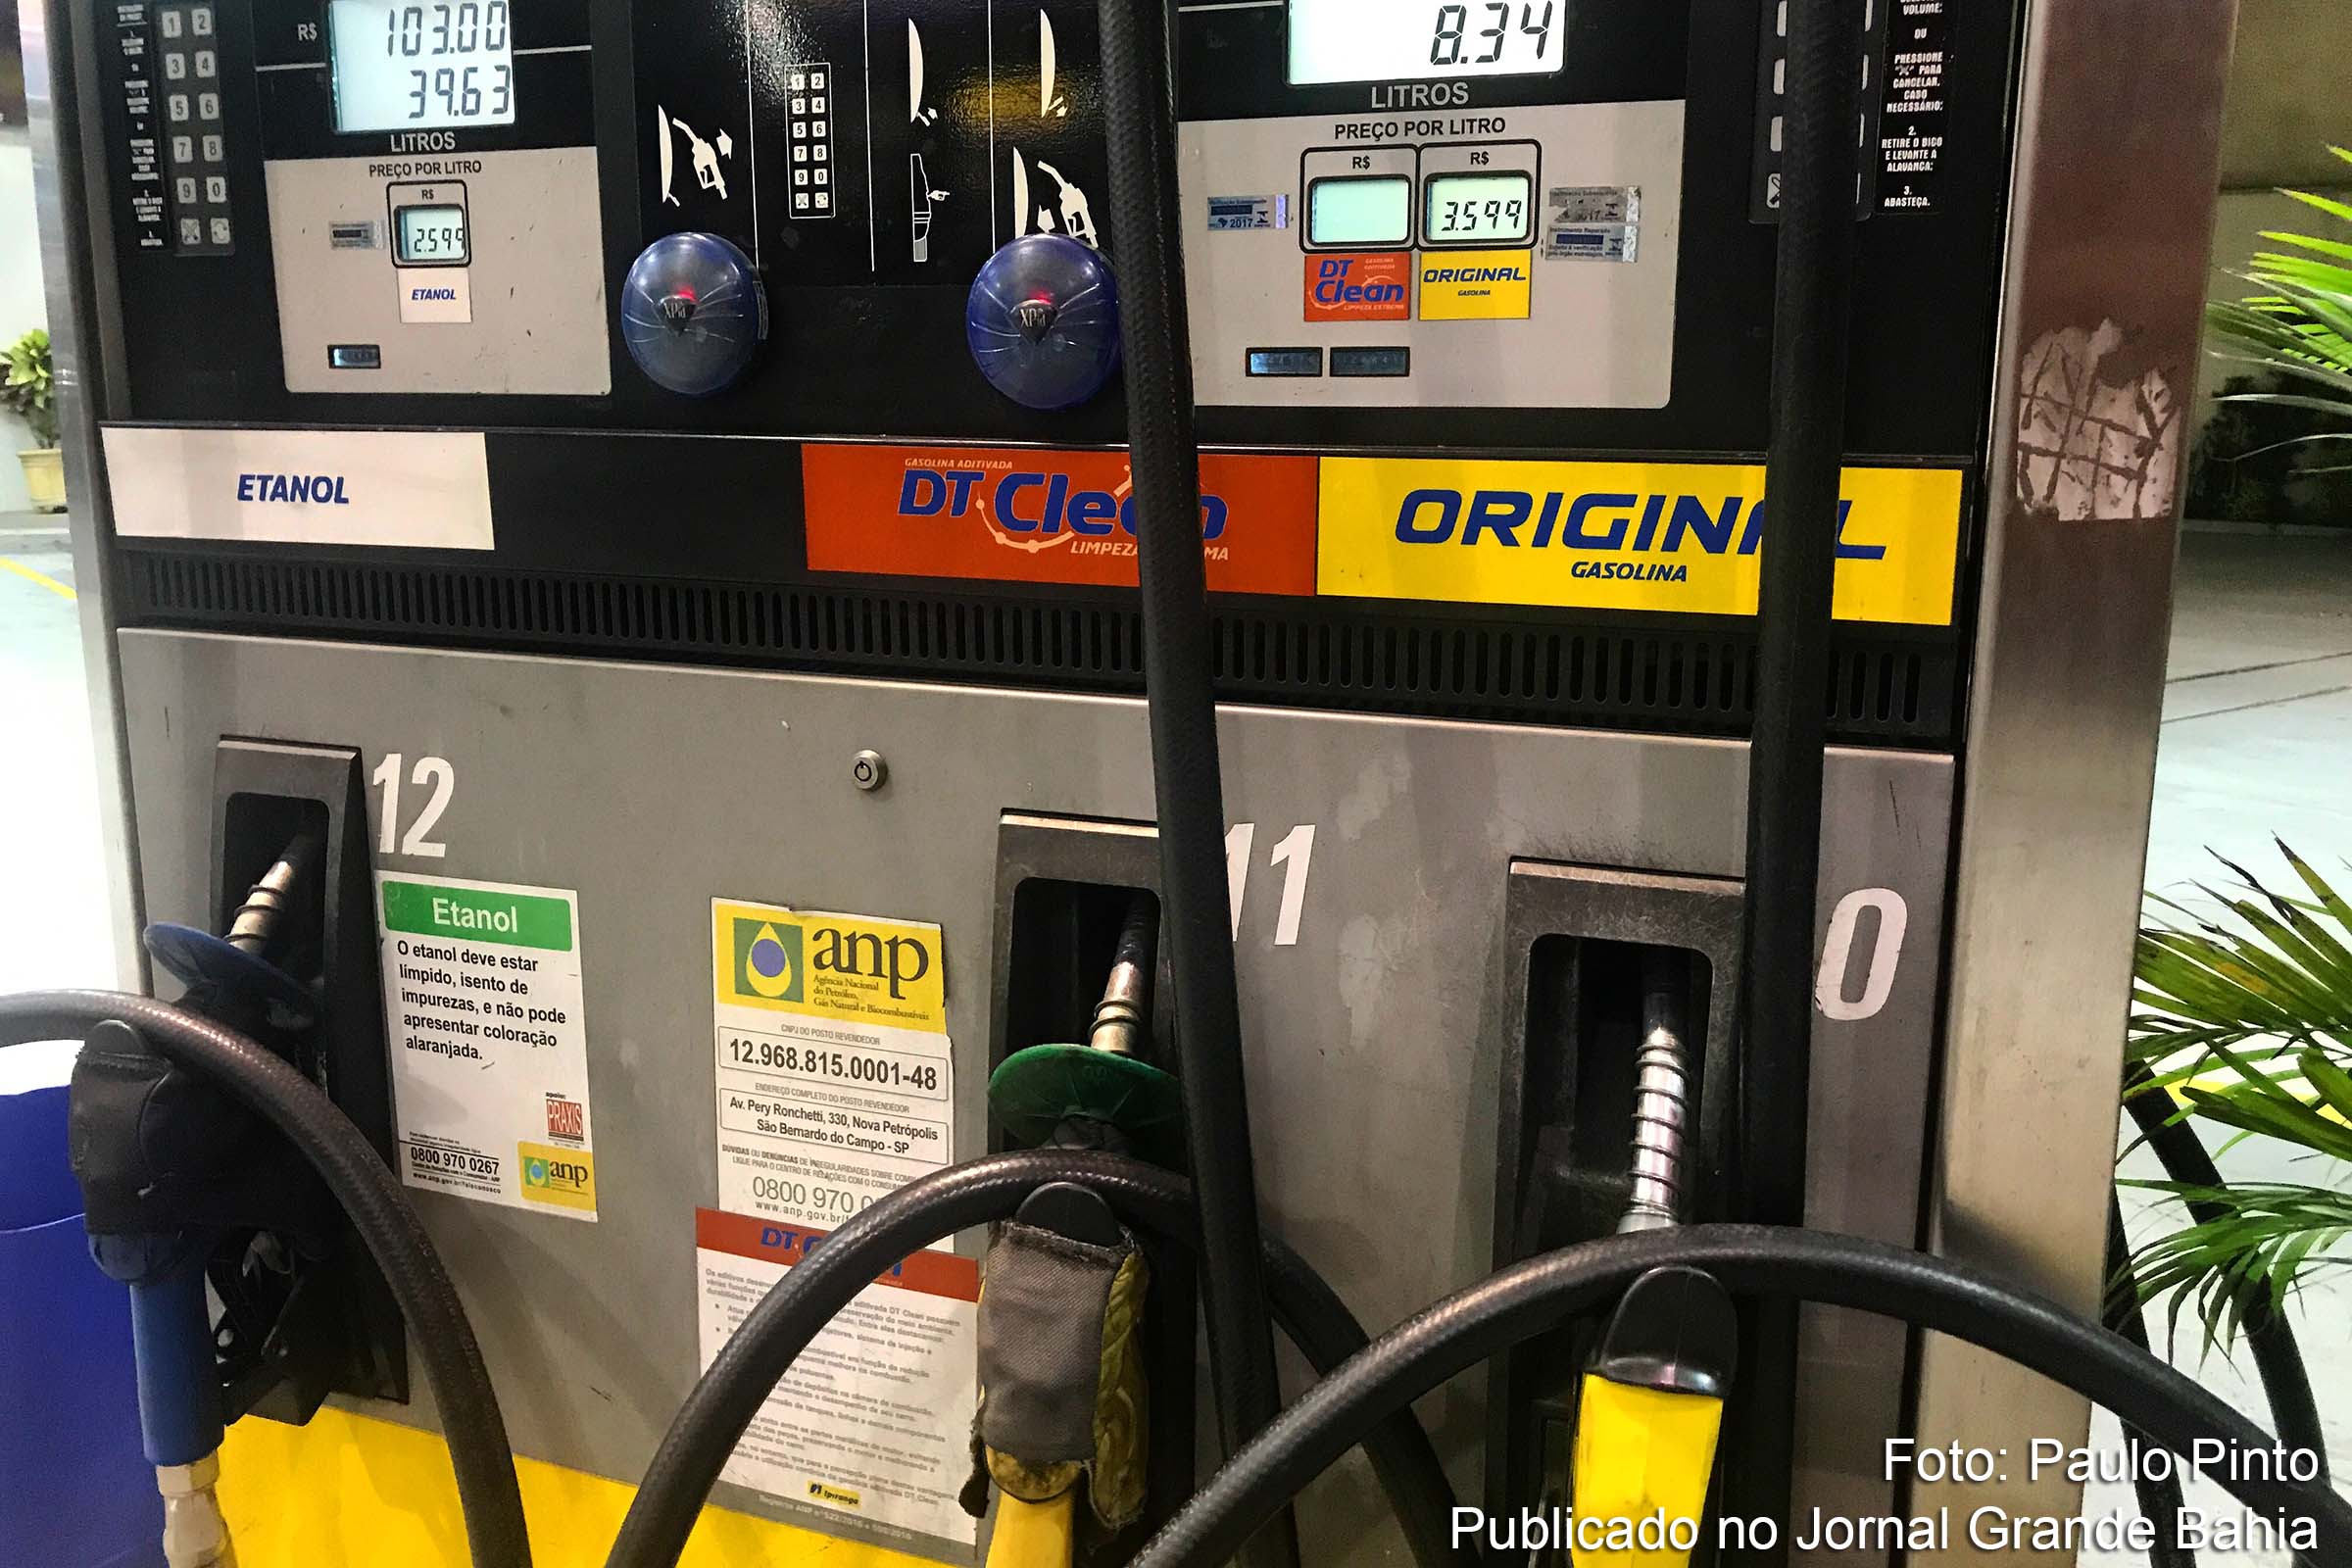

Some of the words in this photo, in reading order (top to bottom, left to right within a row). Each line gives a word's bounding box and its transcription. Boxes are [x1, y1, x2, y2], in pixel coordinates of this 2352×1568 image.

[198, 15, 206, 29] 2
[297, 23, 318, 42] R$
[387, 1, 507, 56] 103.00
[1430, 1, 1552, 65] 8.34
[1914, 27, 1927, 39] OU
[172, 60, 179, 74] 3
[202, 57, 210, 71] 4
[1894, 51, 1943, 64] PRESSIONE
[1919, 64, 1941, 74] PARA
[409, 65, 511, 119] 39.63
[1372, 82, 1469, 109] LITROS
[1904, 89, 1928, 100] CASO
[175, 101, 183, 116] 5
[206, 99, 214, 114] 6
[1335, 122, 1398, 141] PREÇO
[1404, 120, 1445, 136] POR
[1449, 118, 1506, 135] LITRO
[1908, 125, 1917, 135] 2.
[178, 142, 186, 157] 7
[209, 141, 217, 156] 8
[390, 131, 456, 152] LITROS
[1882, 138, 1911, 148] RETIRE
[1913, 137, 1919, 147] O
[1922, 137, 1942, 147] BICO
[1352, 155, 1370, 170] R$
[1470, 151, 1490, 166] R$
[1886, 151, 1890, 160] E
[1892, 150, 1929, 160] LEVANTE
[369, 163, 412, 179] PREÇO
[416, 162, 441, 174] POR
[445, 160, 482, 173] LITRO
[182, 183, 190, 198] 9
[213, 183, 220, 196] 0
[422, 189, 434, 200] R$
[1903, 185, 1912, 195] 3.
[1885, 197, 1931, 208] ABASTEÇA.
[1230, 218, 1253, 228] 2017
[1442, 199, 1522, 231] 3.599
[415, 228, 465, 253] 2.599
[1319, 259, 1353, 278] DT
[1423, 268, 1526, 282] ORIGINAL
[412, 289, 457, 301] ETANOL
[1315, 280, 1404, 303] Clean
[905, 458, 954, 467] GASOLINA
[956, 460, 1012, 468] ADITIVADA
[237, 473, 349, 504] ETANOL
[898, 468, 986, 517] DT
[994, 472, 1229, 540] Clen
[1395, 488, 1887, 560] ORIGINL
[1571, 561, 1688, 583] GASOLINA
[372, 753, 455, 858] 12
[1224, 823, 1316, 946] 11
[432, 897, 517, 933] Etanol
[397, 941, 409, 956] O
[413, 943, 457, 962] etanol
[462, 949, 496, 967] deve
[501, 956, 538, 972] estar
[812, 928, 929, 1001] anp
[399, 963, 457, 988] límpido,
[461, 972, 505, 991] isento
[510, 979, 528, 995] de
[845, 978, 879, 990] Nacional
[401, 988, 479, 1014] impurezas,
[483, 1001, 491, 1014] e
[496, 1003, 523, 1019] não
[528, 1006, 566, 1025] pode
[830, 1001, 859, 1011] Natural
[404, 1013, 479, 1036] apresentar
[484, 1025, 558, 1048] coloração
[800, 1028, 810, 1037] DO
[810, 1029, 834, 1040] POSTO
[835, 1032, 880, 1046] REVENDEDOR
[406, 1036, 483, 1059] alaranjada.
[730, 1038, 938, 1091] 12.968.815.0001-48
[756, 1083, 791, 1096] ENDEREÇO
[791, 1088, 828, 1101] COMPLETO
[828, 1093, 839, 1102] DO
[840, 1094, 862, 1105] POSTO
[863, 1098, 909, 1113] REVENDEDOR
[548, 1100, 582, 1135] PRAXIS
[730, 1097, 746, 1109] Av.
[748, 1099, 770, 1116] Pery
[773, 1103, 826, 1125] Ronchetti,
[828, 1112, 850, 1128] 330,
[853, 1116, 880, 1132] Nova
[883, 1120, 938, 1141] Petrópolis
[757, 1118, 776, 1133] São
[780, 1121, 827, 1141] Bernardo
[830, 1132, 844, 1144] do
[847, 1133, 885, 1152] Campo
[894, 1141, 909, 1154] SP
[412, 1147, 439, 1164] 0800
[443, 1152, 466, 1169] 970
[469, 1157, 499, 1175] 0267
[549, 1160, 588, 1188] anp
[753, 1176, 806, 1204] 0800
[813, 1187, 854, 1213] 970
[760, 1227, 798, 1250] DT
